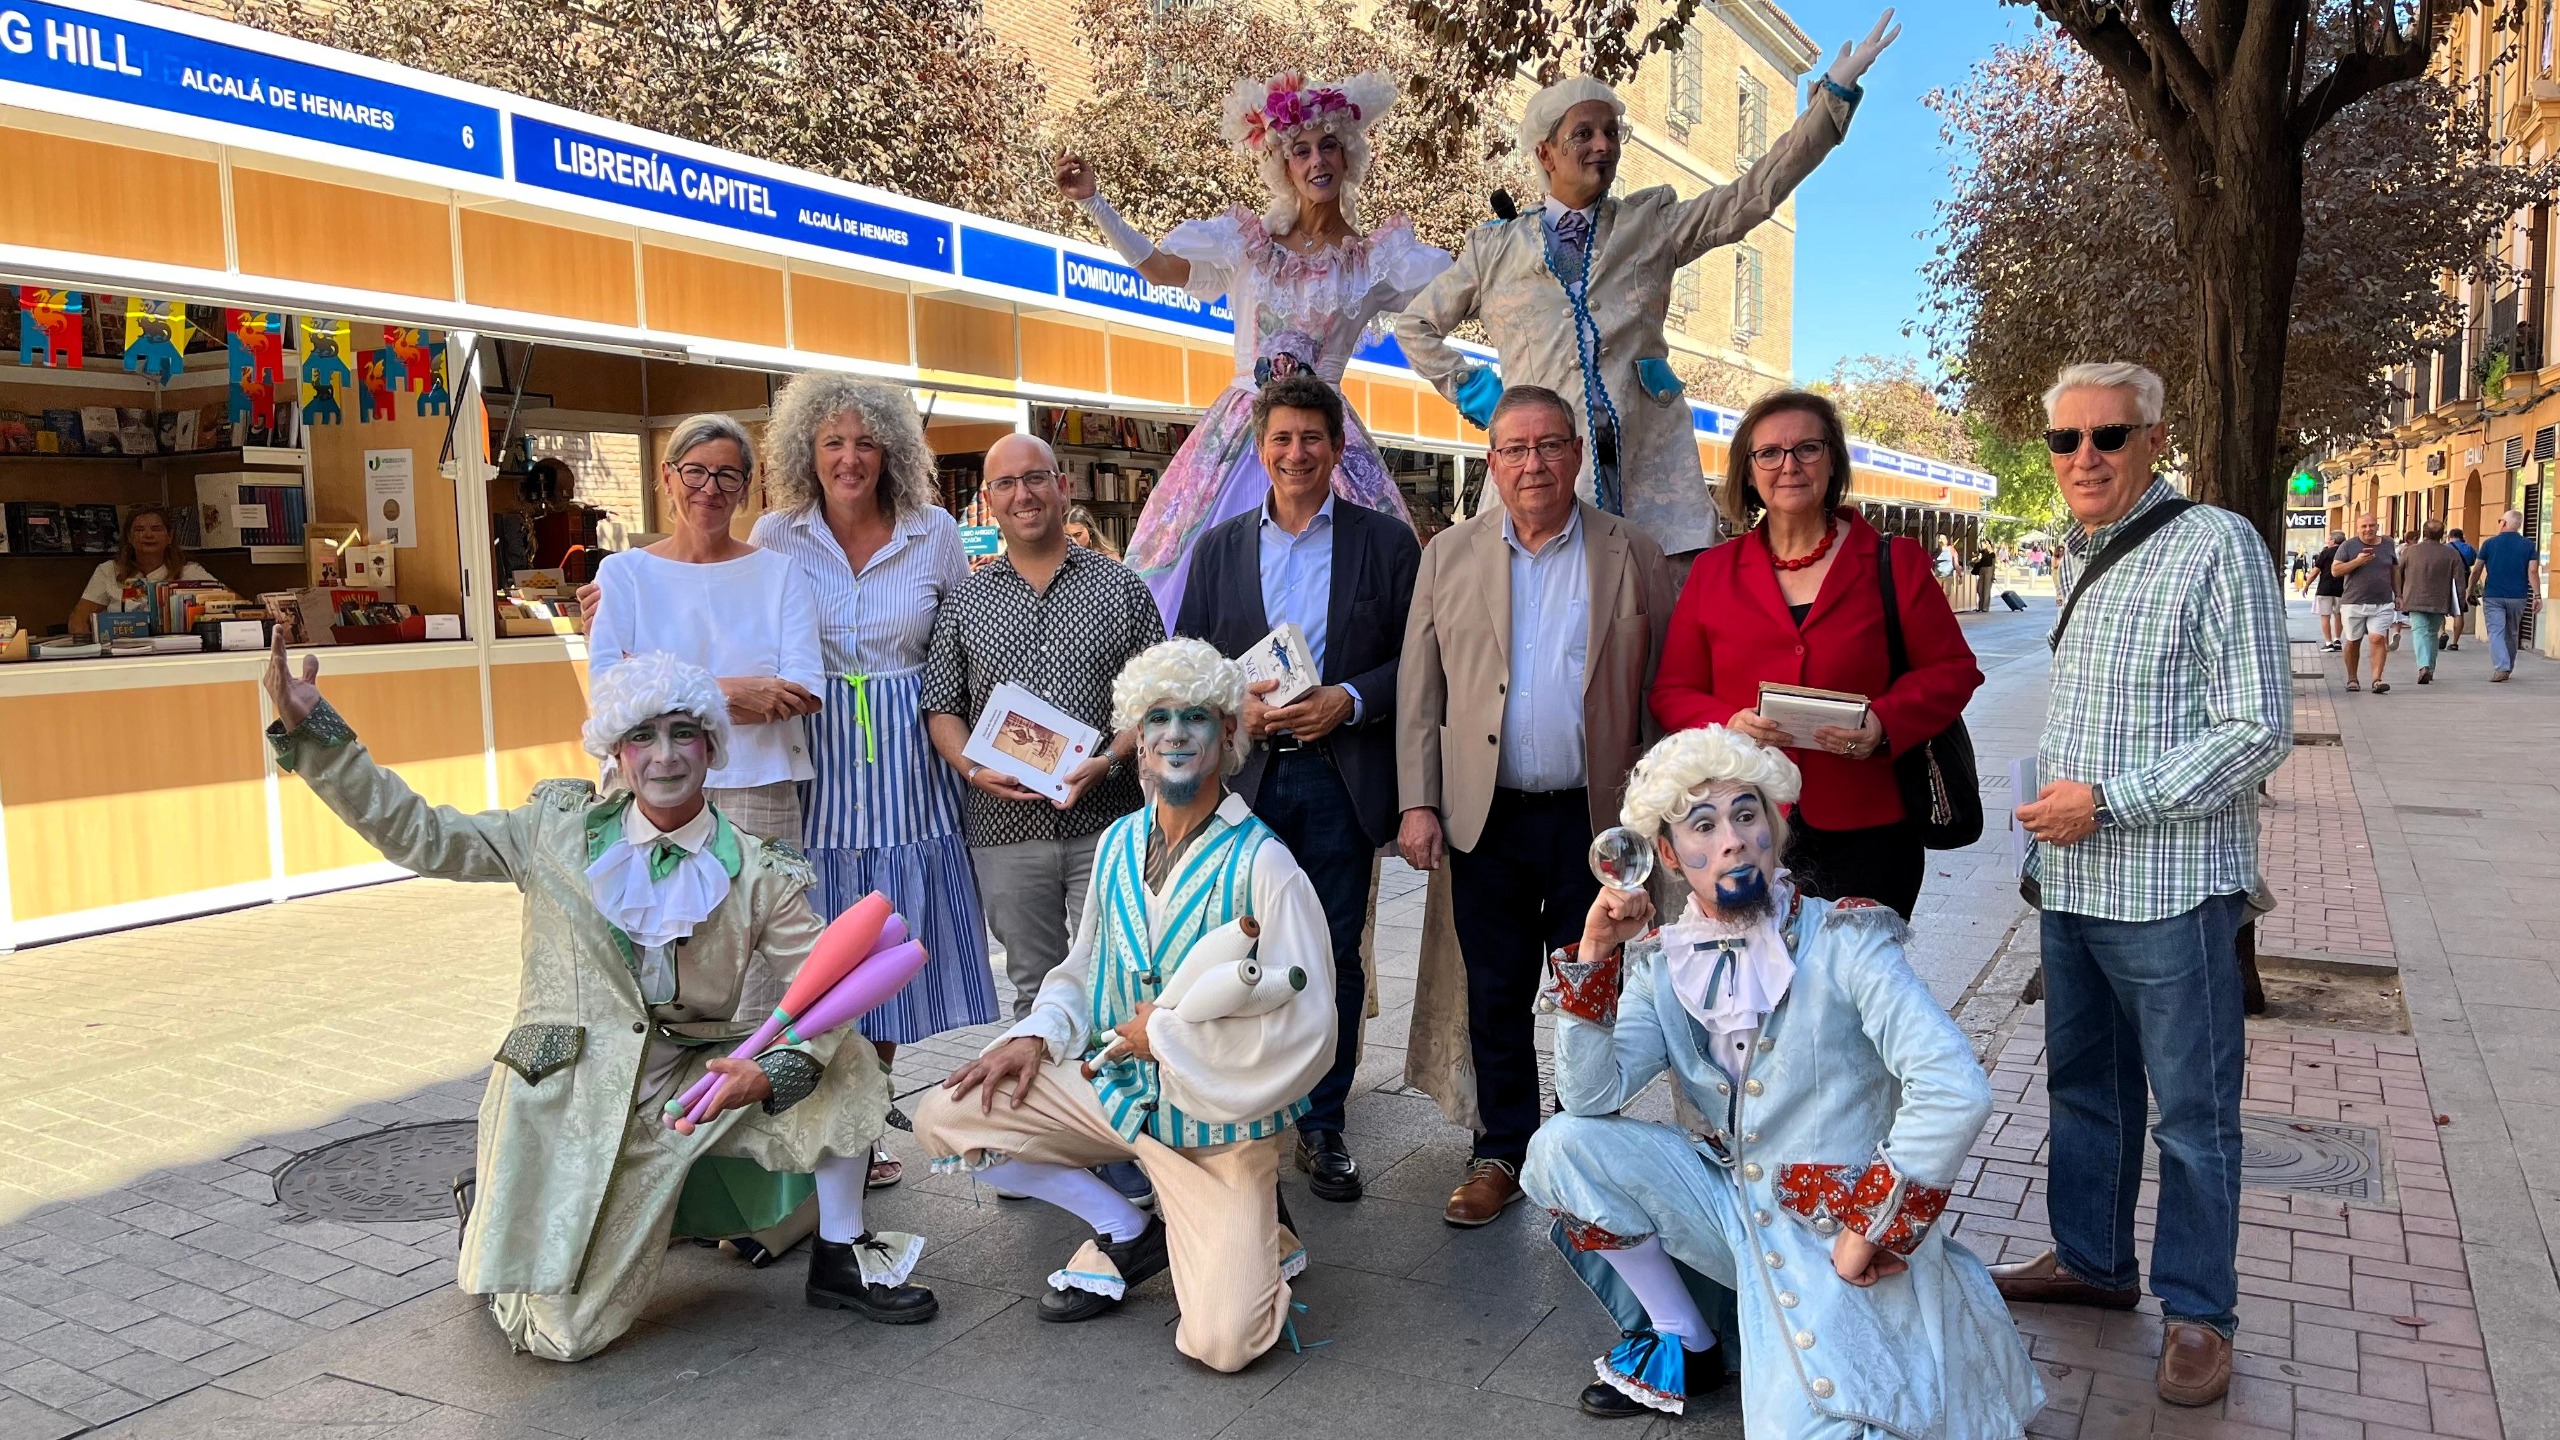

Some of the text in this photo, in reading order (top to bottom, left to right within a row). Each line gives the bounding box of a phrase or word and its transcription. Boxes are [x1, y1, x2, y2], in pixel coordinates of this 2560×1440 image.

[45, 18, 142, 77] HILL
[181, 67, 395, 131] ALCALÁ DE HENARES
[461, 125, 475, 149] 6
[553, 137, 777, 217] LIBRERÍA CAPITEL
[798, 208, 909, 246] ALCALÁ DE HENARES
[936, 237, 945, 254] 7
[1067, 260, 1201, 313] DOMIDUCA LIBREROS
